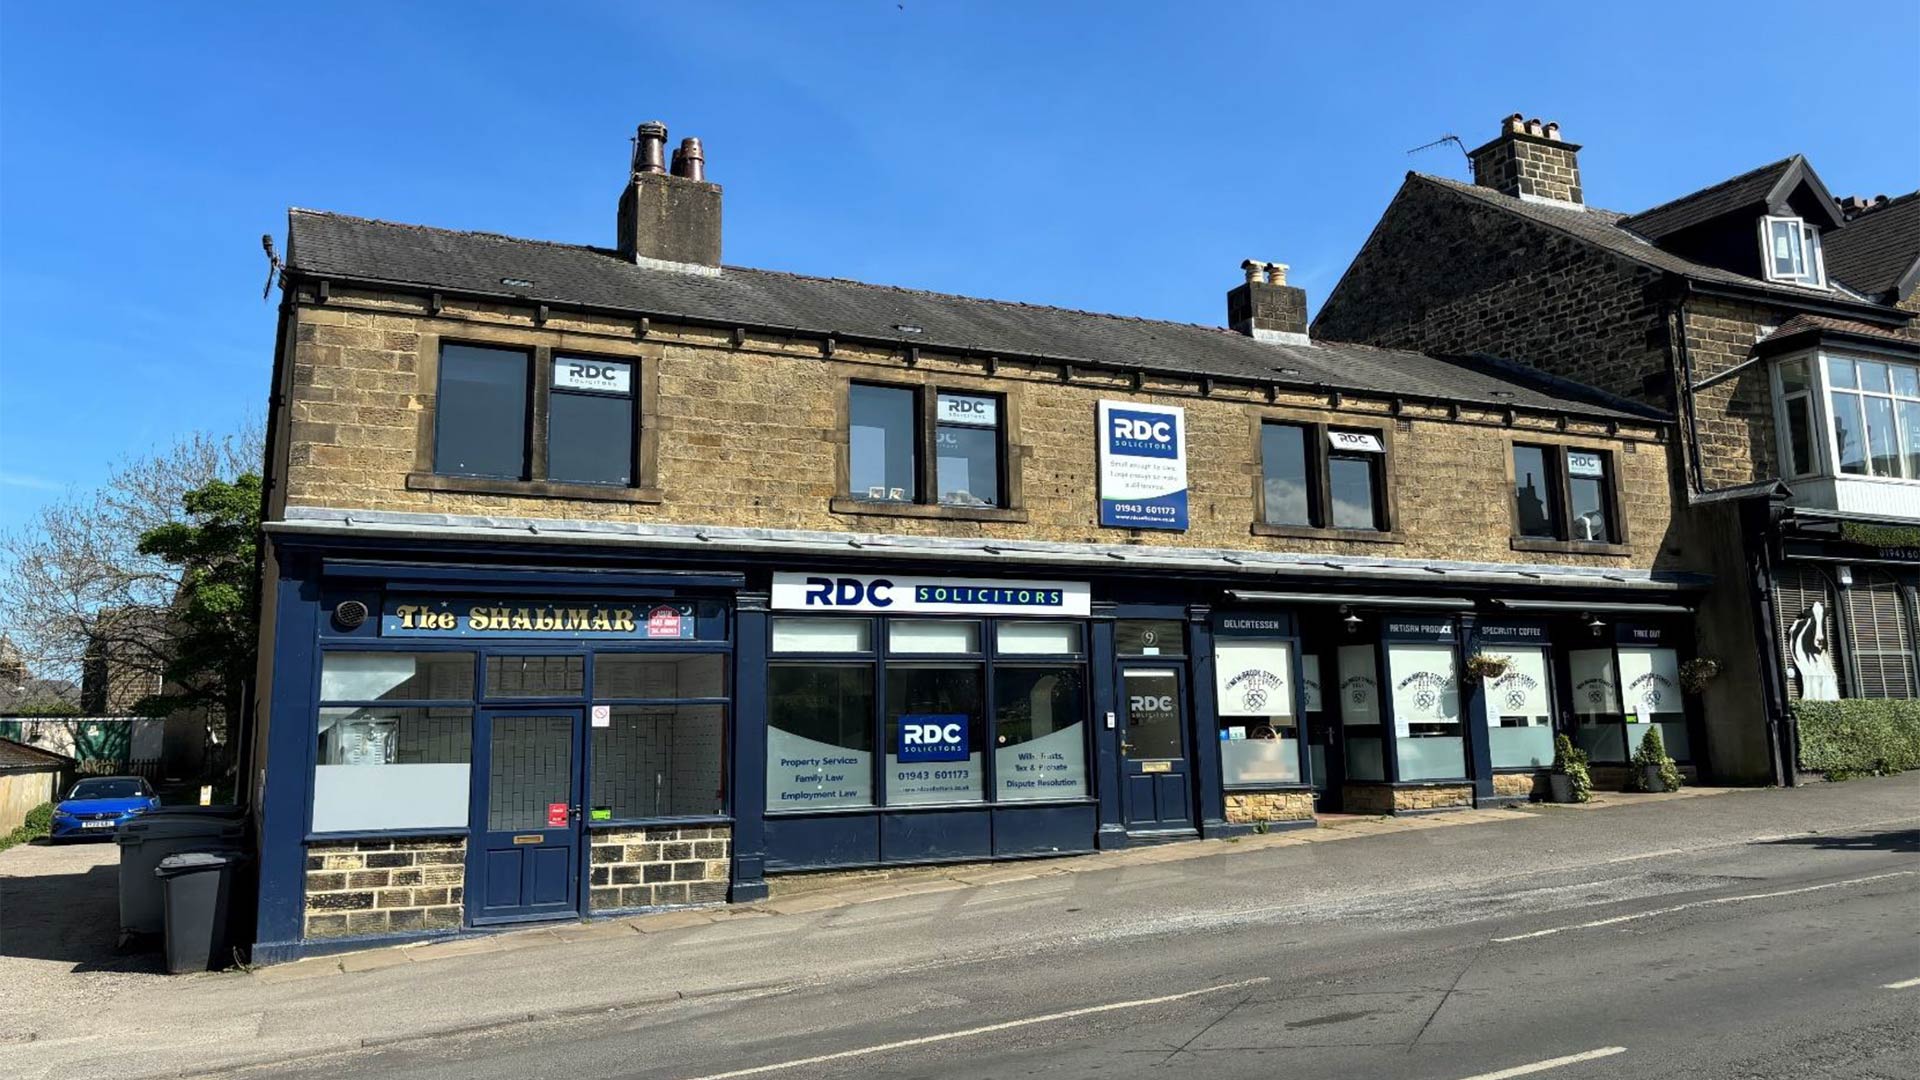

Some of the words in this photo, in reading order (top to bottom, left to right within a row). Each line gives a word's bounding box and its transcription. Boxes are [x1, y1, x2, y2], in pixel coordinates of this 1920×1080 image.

[569, 363, 616, 380] RDC
[948, 399, 985, 413] RDC
[1114, 418, 1171, 442] RDC
[1337, 433, 1368, 444] RDC
[1115, 440, 1172, 451] SOLICITORS
[1571, 456, 1595, 467] RDC
[1115, 503, 1142, 513] 01943
[1145, 506, 1176, 515] 601173
[805, 577, 894, 607] RDC
[919, 588, 1059, 603] SOLICITORS
[397, 604, 455, 629] The
[468, 606, 636, 632] SHALIMAR
[1224, 620, 1279, 629] DELICATESSEN
[1390, 624, 1419, 633] ARTISAN
[1420, 625, 1452, 634] PRODUCE
[1482, 627, 1517, 635] SPECIALITY
[1518, 627, 1541, 636] COFFEE
[1633, 630, 1648, 638] TAKE
[1649, 630, 1661, 638] OUT
[1145, 632, 1154, 644] 9
[1130, 695, 1172, 711] RDC
[904, 724, 961, 744] RDC
[781, 758, 820, 767] Property
[823, 757, 858, 765] Services
[795, 774, 822, 783] Family
[898, 771, 929, 780] 01943
[934, 770, 969, 779] 601173
[1007, 780, 1035, 788] Dispute
[781, 791, 836, 800] Employment
[839, 790, 858, 798] Law
